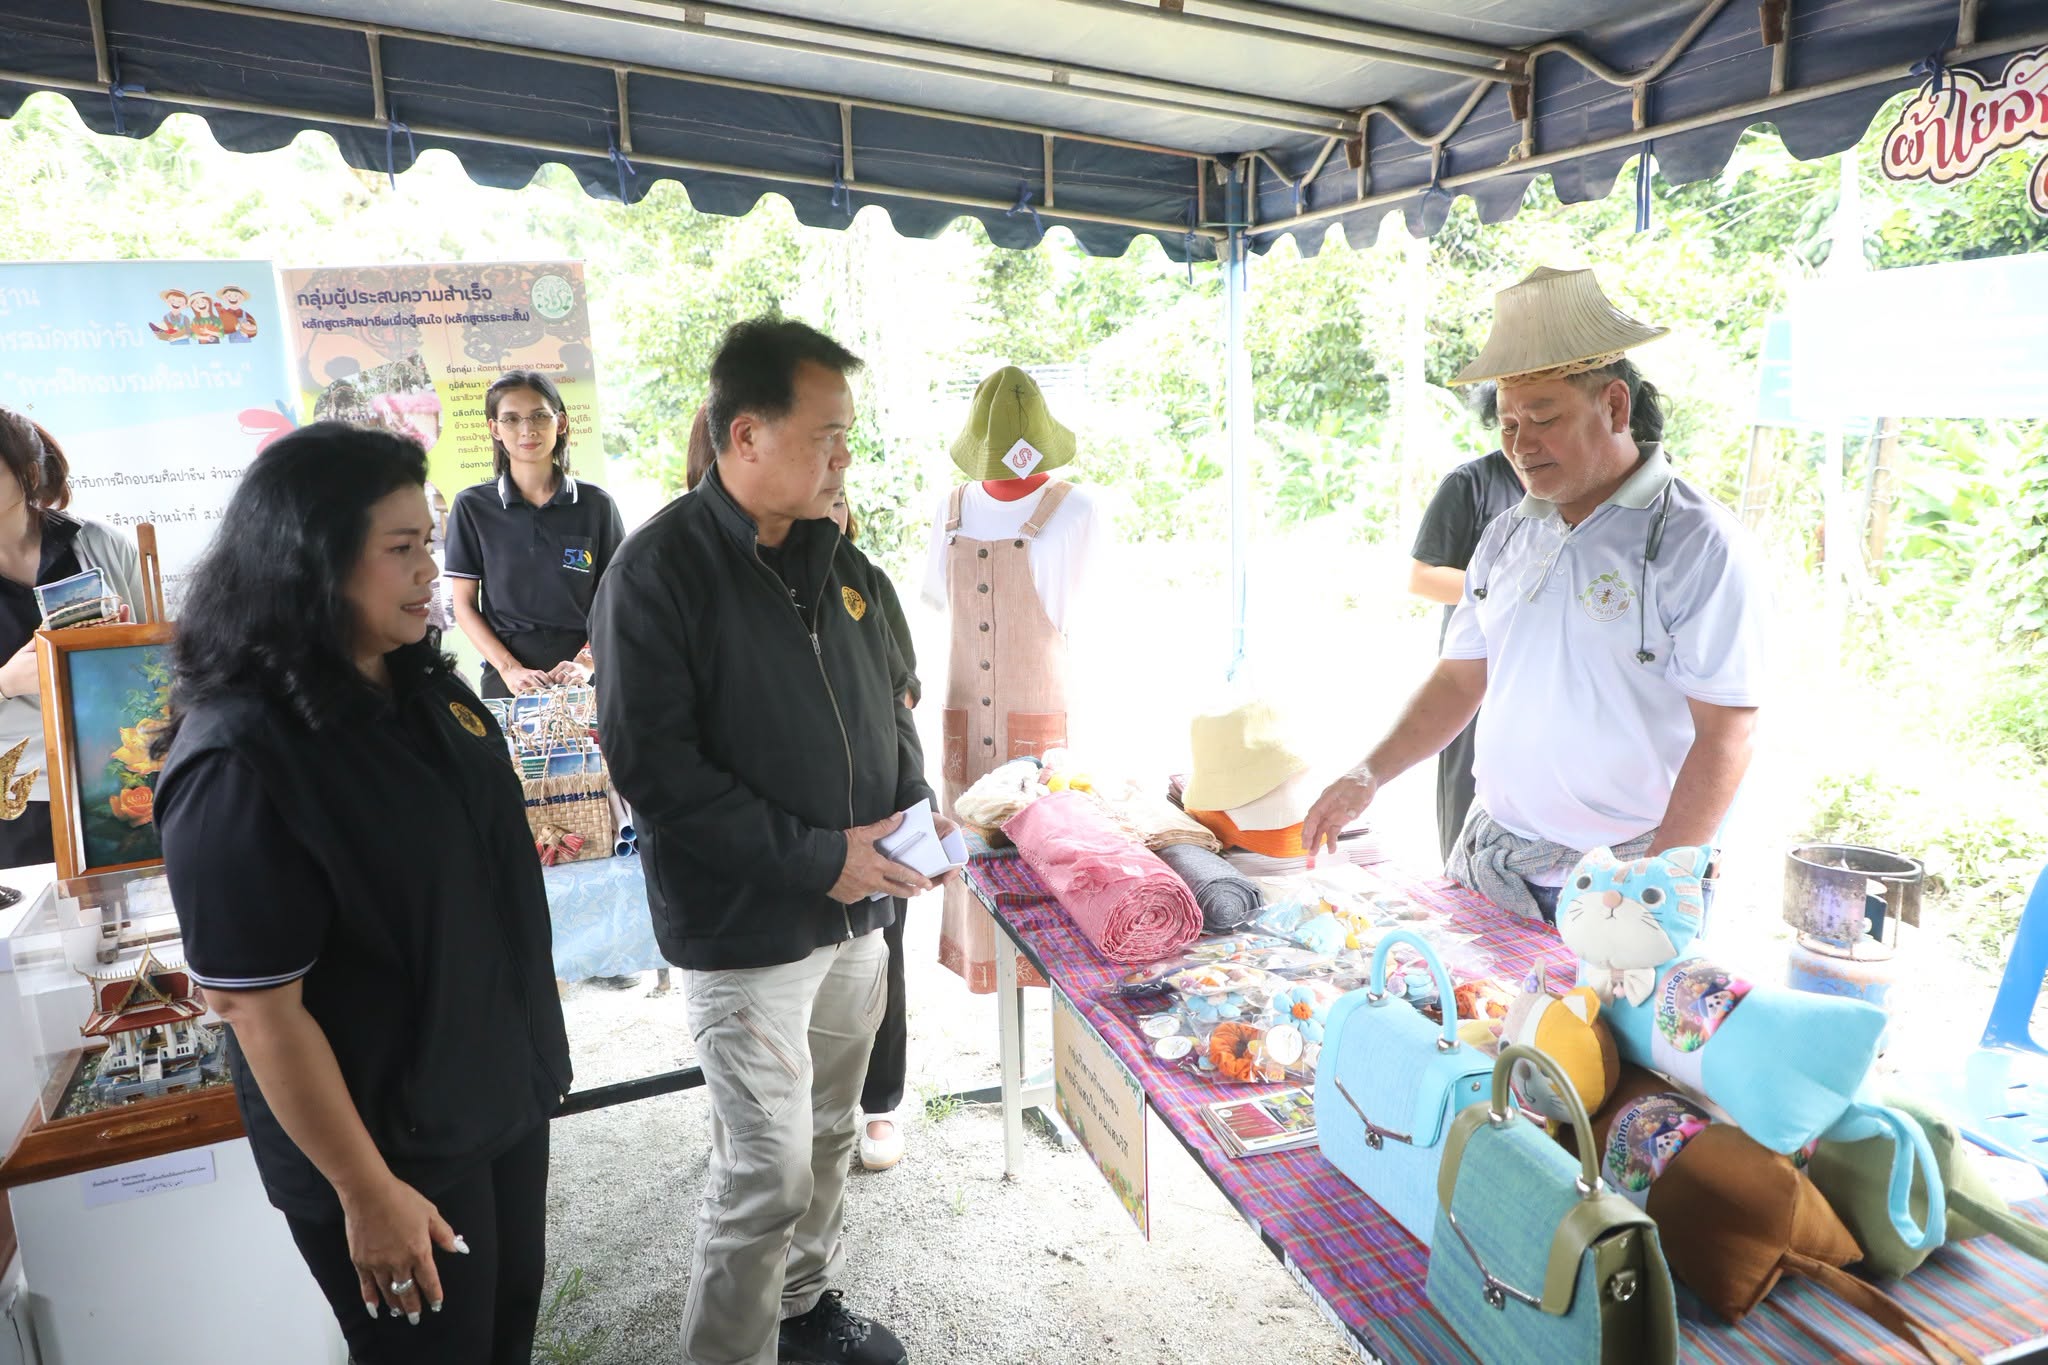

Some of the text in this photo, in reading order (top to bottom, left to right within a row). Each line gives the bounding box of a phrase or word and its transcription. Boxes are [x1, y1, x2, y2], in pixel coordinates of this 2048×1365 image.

[1891, 62, 2048, 169] ผ้าใยลั
[296, 282, 492, 310] กลุ่มผู้ประสบความสำเร็จ
[302, 308, 530, 331] หลักสูตรศิลปาชีพเพื่อผู้สนใจ (หลักสูตรระยะสั้น)
[536, 362, 564, 370] Change
[453, 409, 487, 417] ผลิตภัณ
[460, 461, 493, 470] ช่องทางก
[68, 467, 205, 489] ข้ารับการฝึกอบรมศิลปาชีพ
[204, 506, 223, 520] ส.ป
